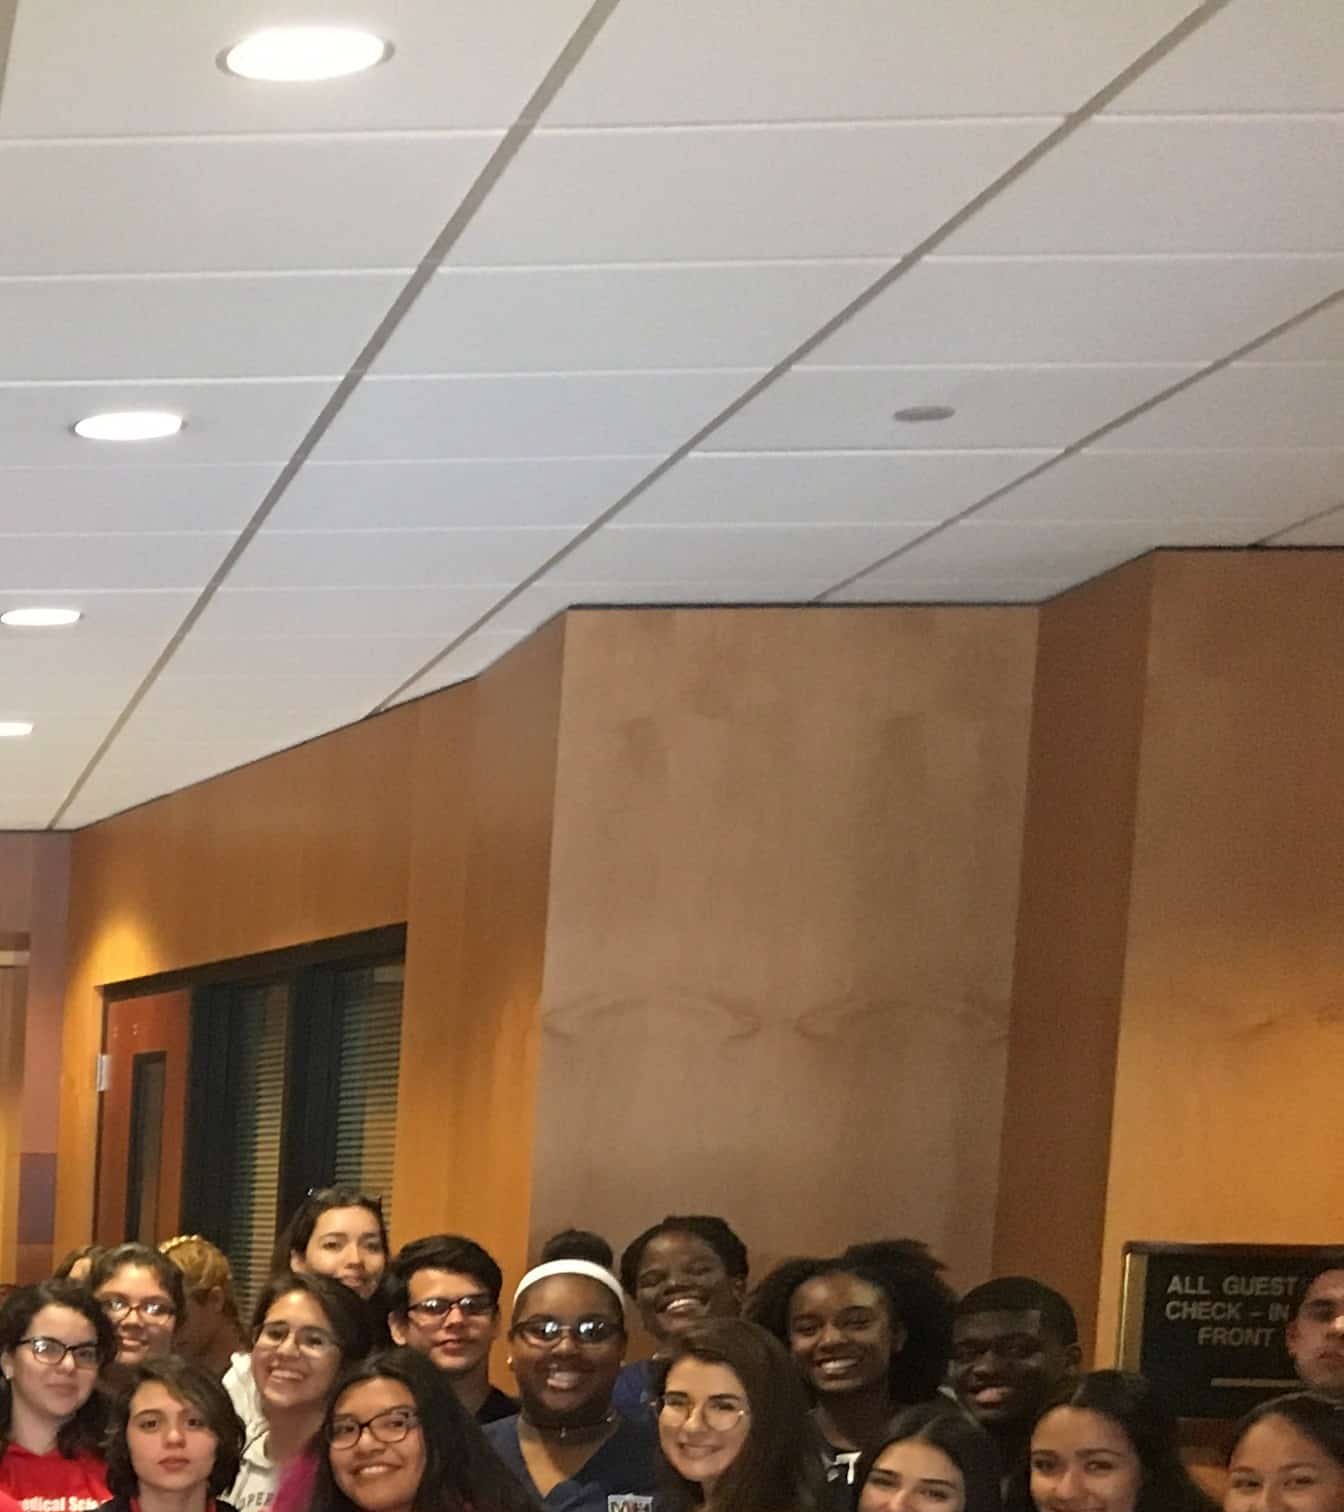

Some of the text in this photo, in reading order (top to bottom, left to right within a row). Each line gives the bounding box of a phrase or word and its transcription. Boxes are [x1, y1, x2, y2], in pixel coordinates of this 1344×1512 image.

[1166, 1275, 1302, 1297] ALL GUEST
[1165, 1300, 1243, 1321] CHECK
[1268, 1302, 1290, 1321] IN
[1197, 1326, 1276, 1347] FRONT
